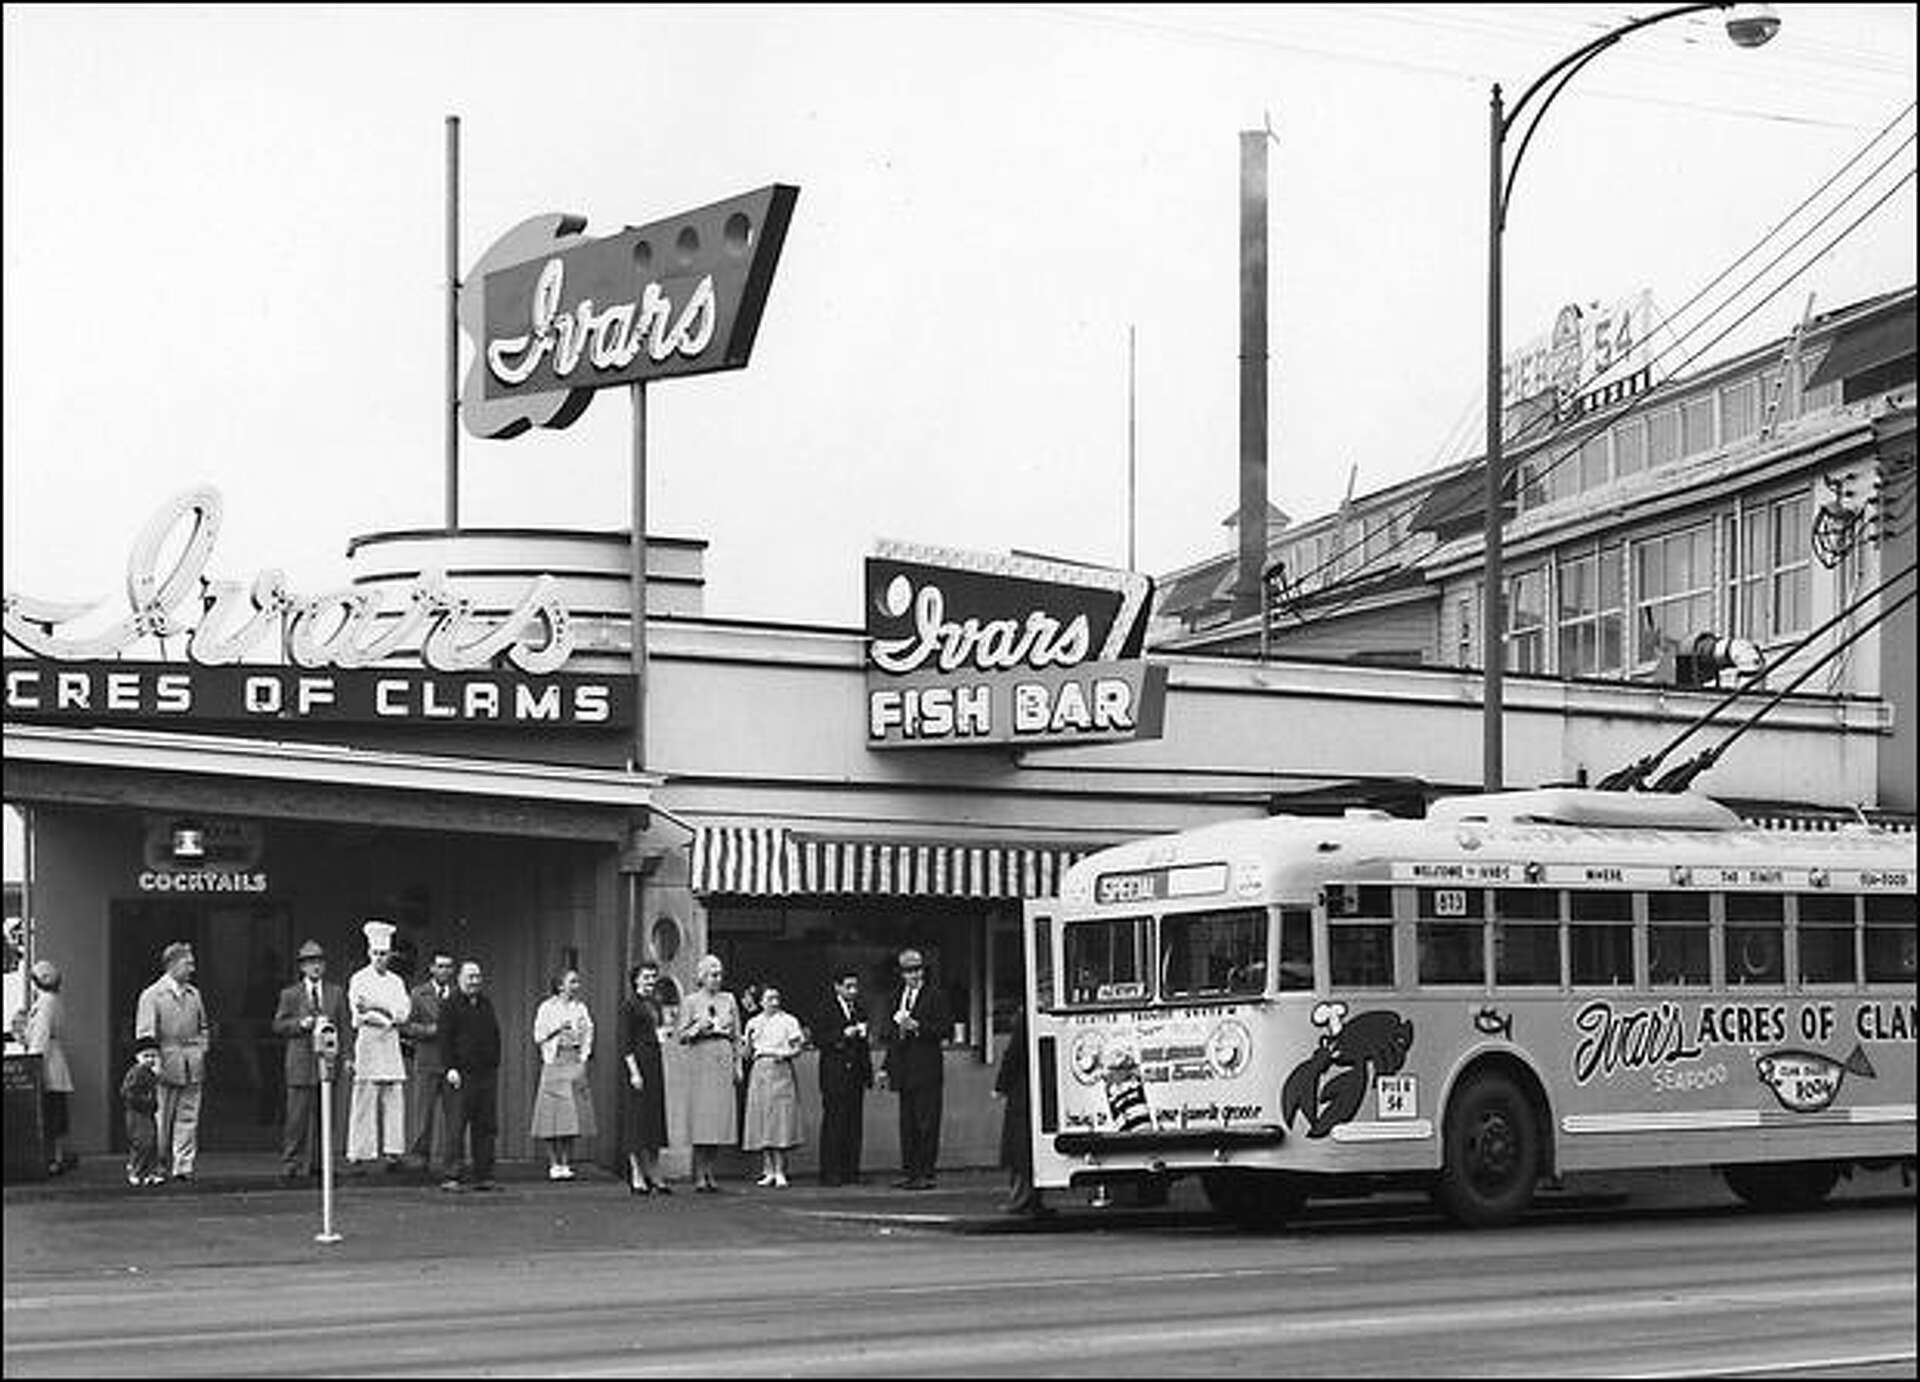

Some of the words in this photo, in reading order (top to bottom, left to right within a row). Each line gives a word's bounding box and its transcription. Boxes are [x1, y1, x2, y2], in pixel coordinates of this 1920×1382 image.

[487, 258, 715, 385] Ivars
[1595, 310, 1632, 372] 54
[870, 585, 1090, 672] Ivars
[5, 671, 191, 711] CRES
[246, 677, 335, 715] OF
[376, 680, 611, 721] CLAMS
[869, 685, 990, 738] FISH
[1014, 680, 1136, 733] BAR
[139, 871, 267, 892] COCKTAILS
[1699, 1006, 1786, 1043] ACRES
[1801, 1006, 1835, 1041] OF
[1382, 1078, 1411, 1093] PIER
[1387, 1094, 1403, 1111] 54
